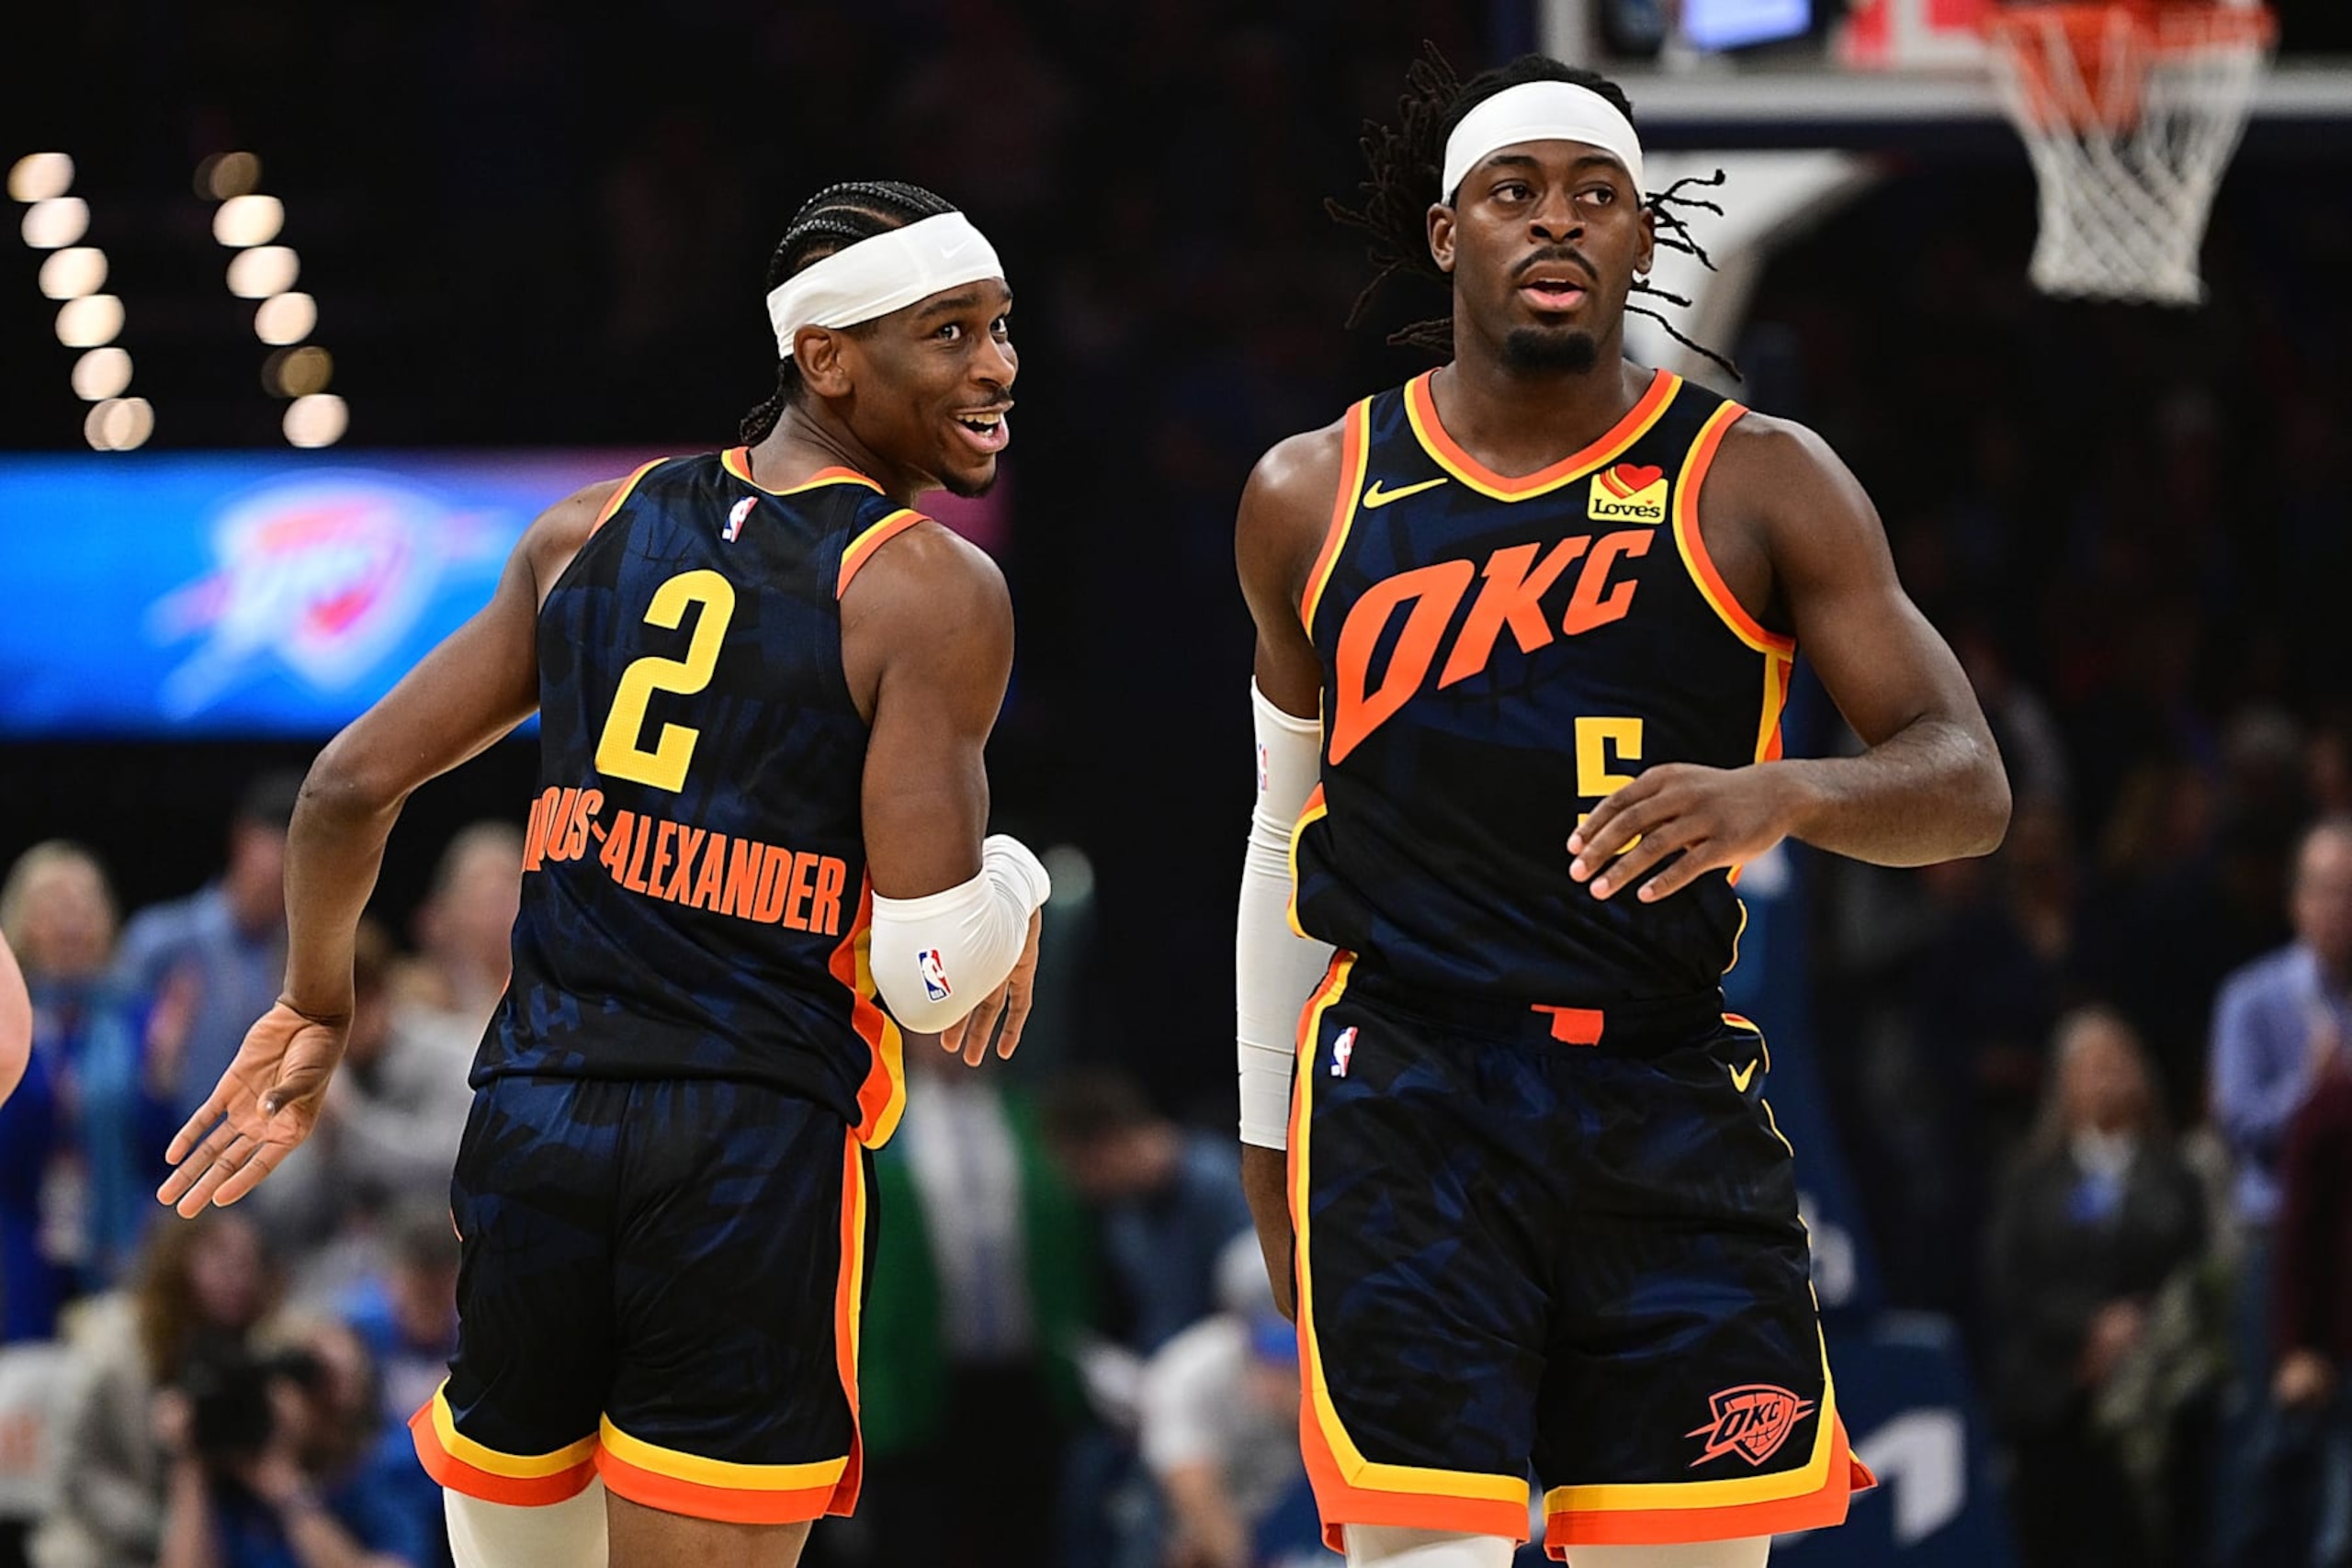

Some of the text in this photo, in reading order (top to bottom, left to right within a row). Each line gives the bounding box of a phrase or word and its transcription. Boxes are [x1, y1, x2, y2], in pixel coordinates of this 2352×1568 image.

[594, 569, 736, 793] 2
[1329, 529, 1655, 765] OKC
[1574, 716, 1644, 855] 5
[1712, 1399, 1781, 1447] OKC
